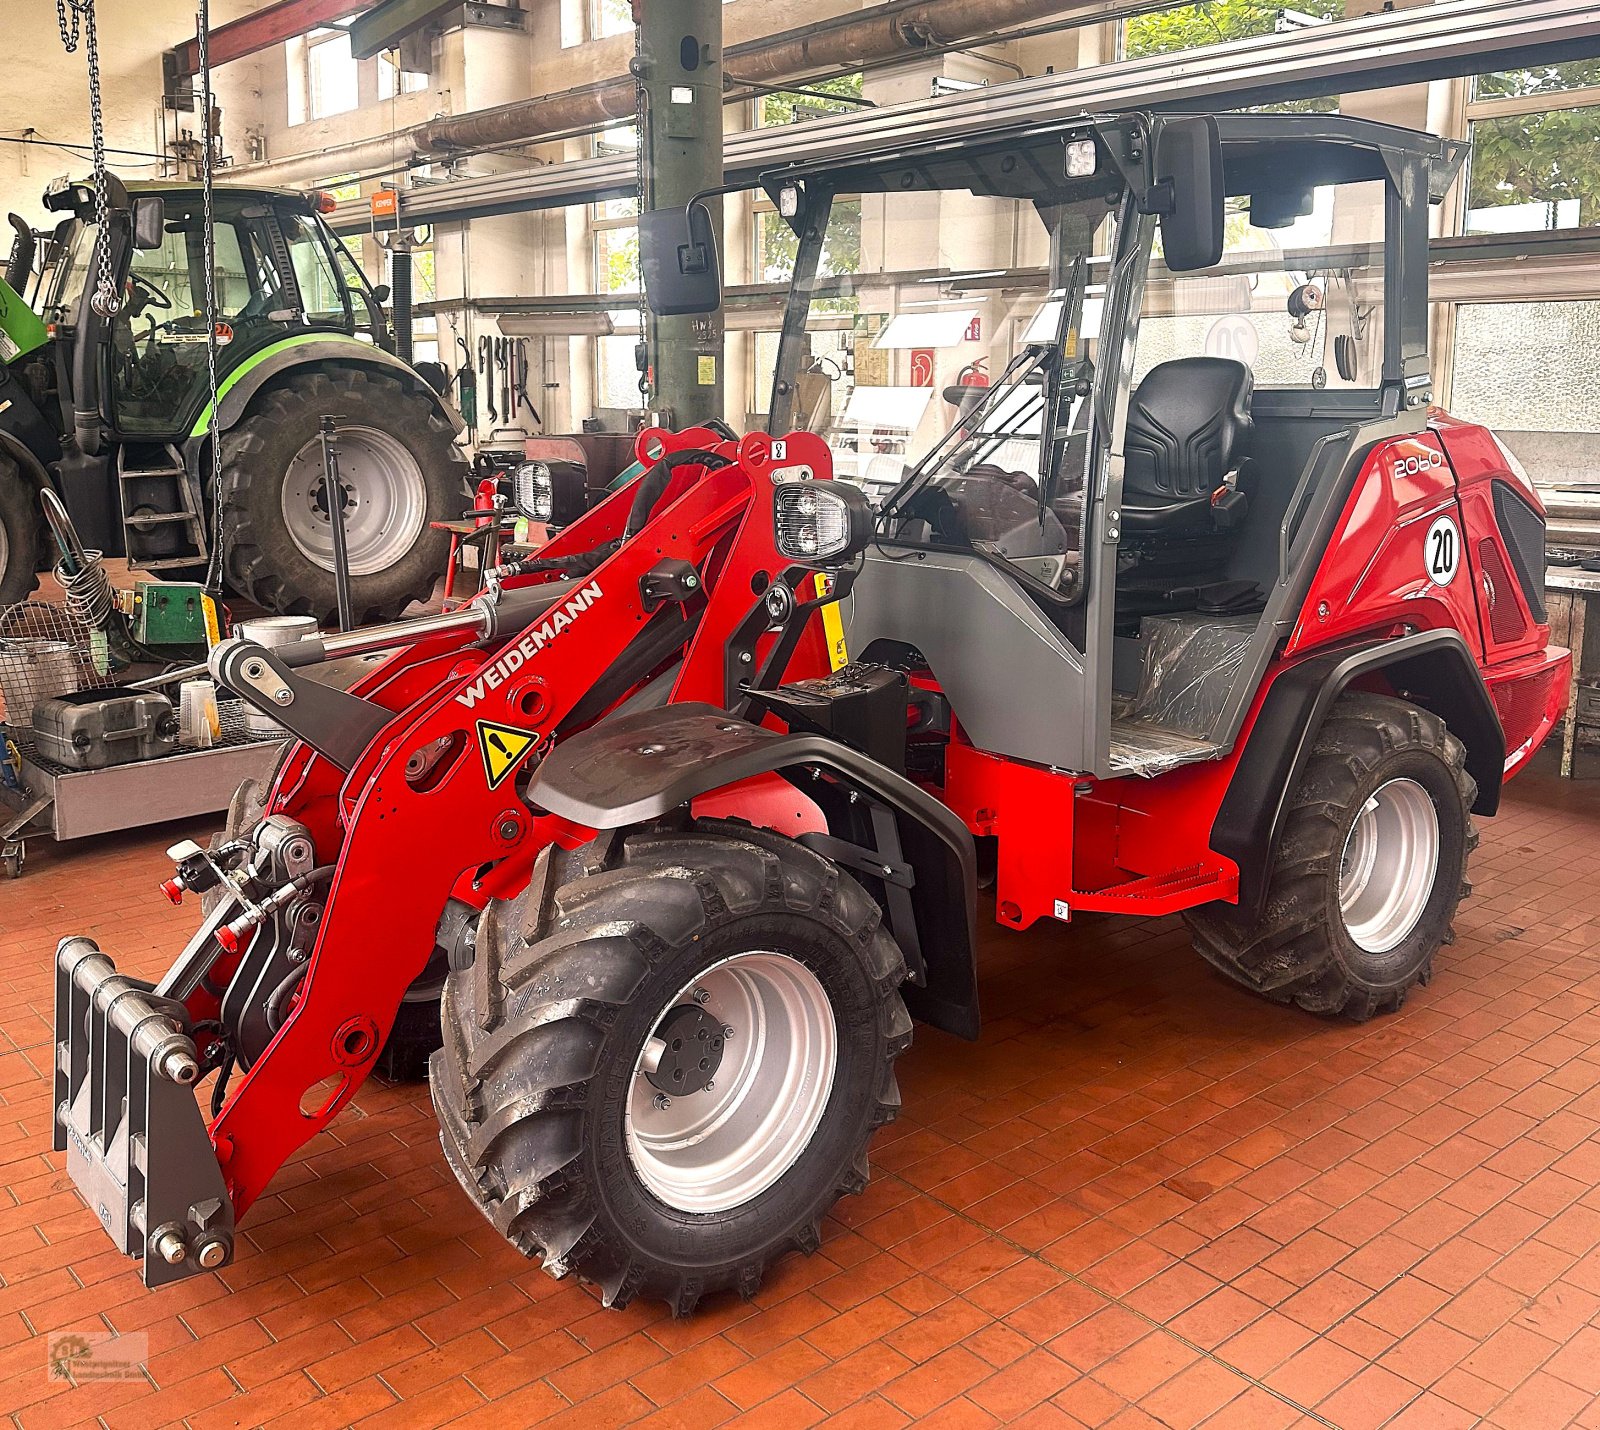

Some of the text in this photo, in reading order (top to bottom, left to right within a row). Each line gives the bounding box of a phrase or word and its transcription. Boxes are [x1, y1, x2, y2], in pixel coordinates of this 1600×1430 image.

[1393, 451, 1442, 479] 2060
[1432, 528, 1453, 574] 20
[454, 580, 604, 708] WEIDEMANN
